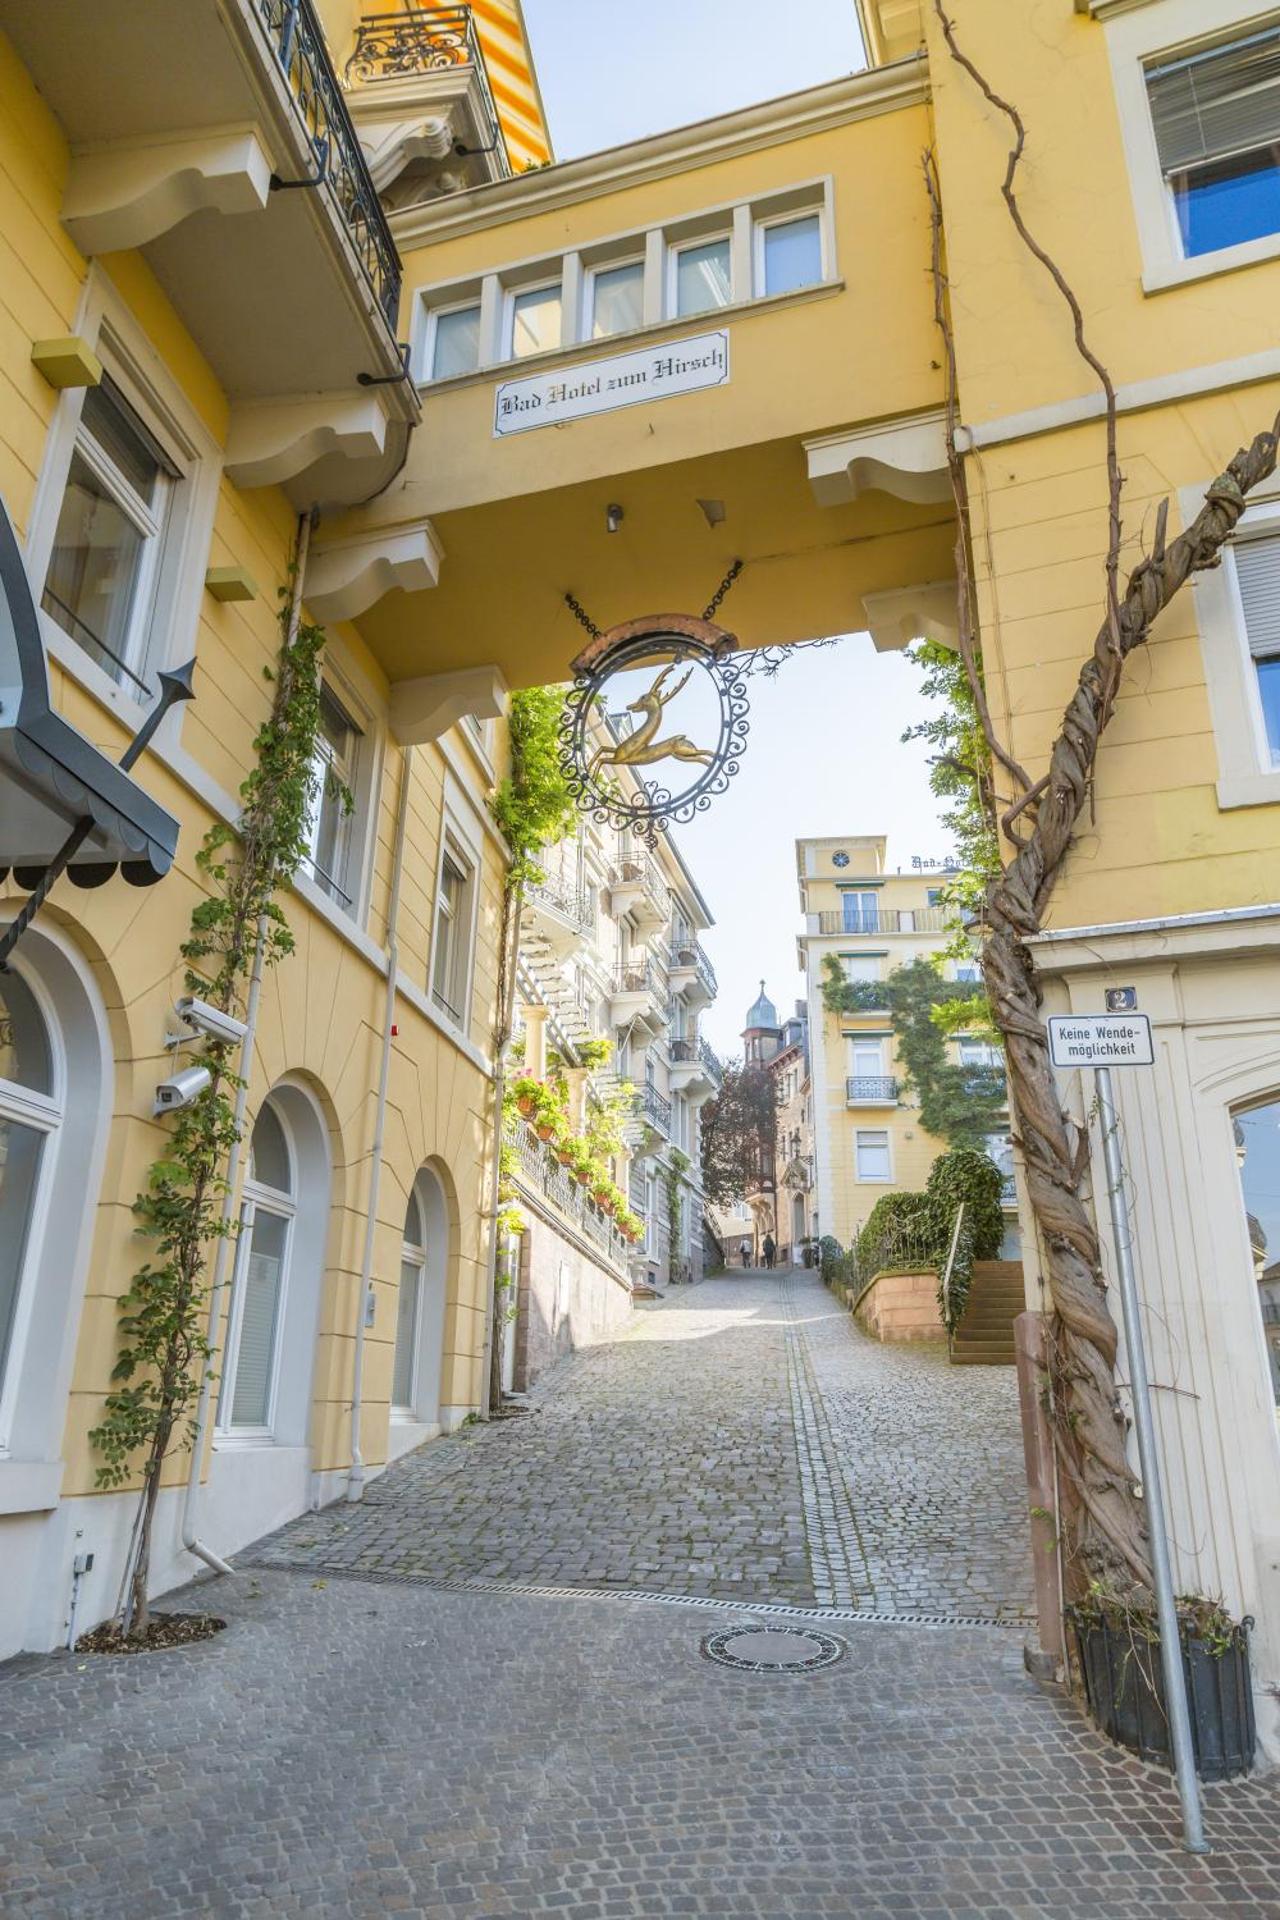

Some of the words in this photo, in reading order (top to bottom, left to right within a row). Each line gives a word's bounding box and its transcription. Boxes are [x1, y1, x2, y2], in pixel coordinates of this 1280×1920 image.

[502, 394, 541, 415] Bad
[546, 378, 600, 404] Hotel
[607, 371, 647, 390] zum
[652, 349, 723, 379] Hirsch
[1114, 992, 1126, 1009] 2
[1059, 1027, 1090, 1040] Keine
[1096, 1026, 1141, 1039] Wende-
[1068, 1042, 1136, 1059] möglichkeit
